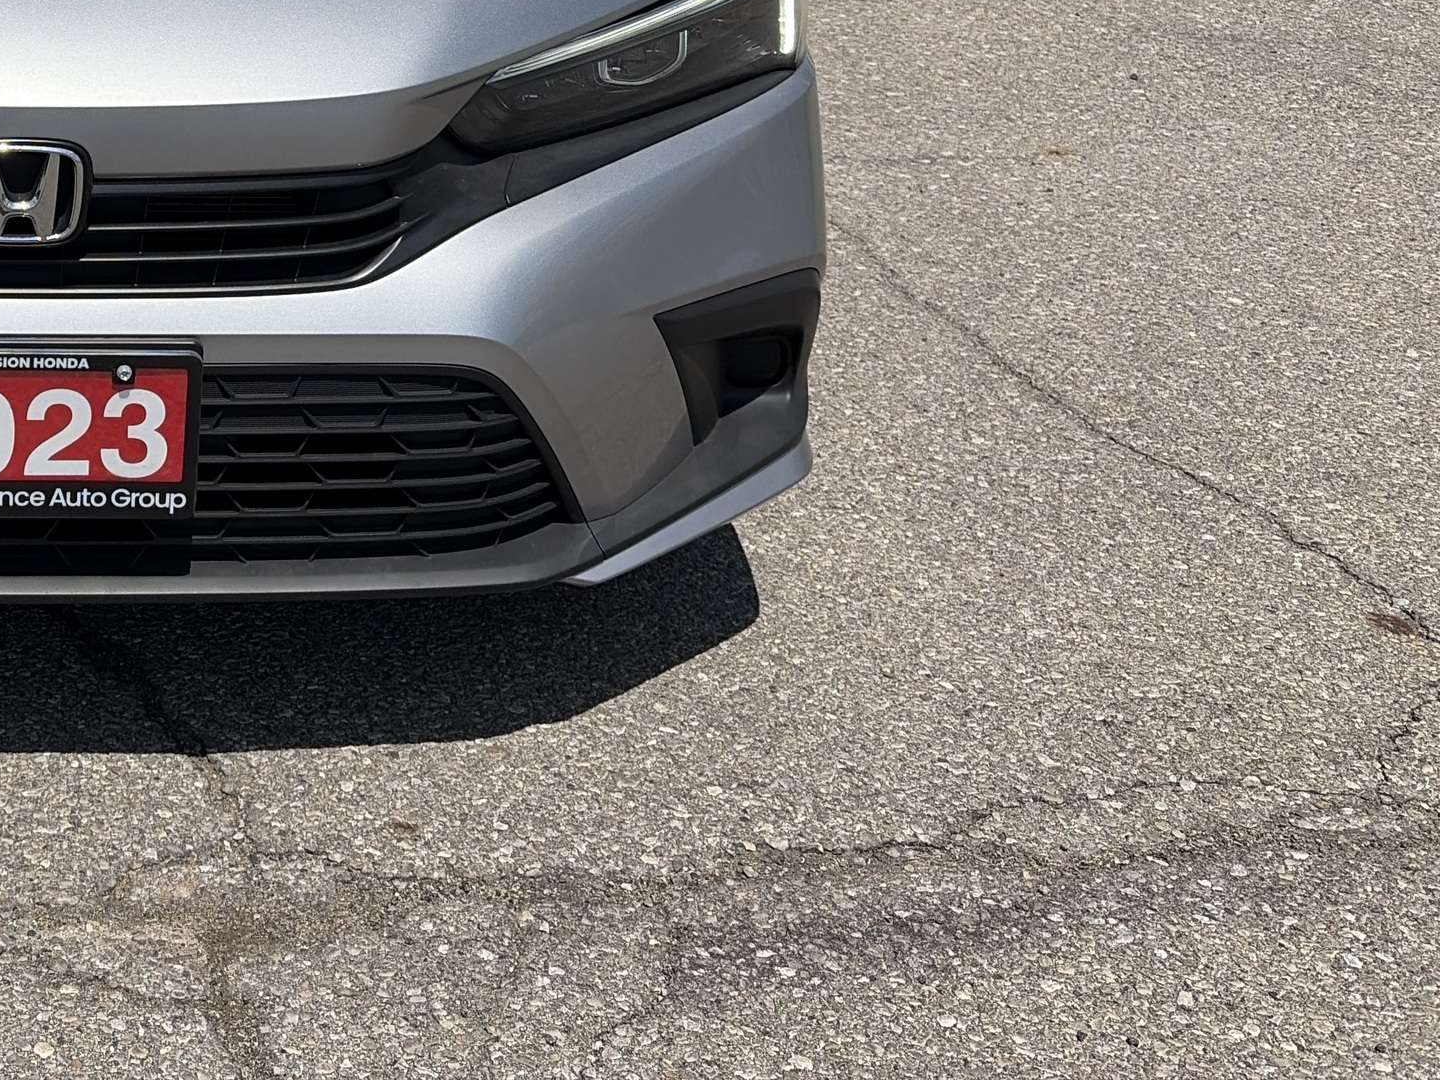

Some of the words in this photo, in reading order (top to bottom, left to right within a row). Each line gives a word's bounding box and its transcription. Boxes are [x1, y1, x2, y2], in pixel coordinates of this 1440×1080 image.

[33, 357, 90, 370] HONDA
[49, 487, 108, 508] Auto
[110, 488, 187, 514] Group
